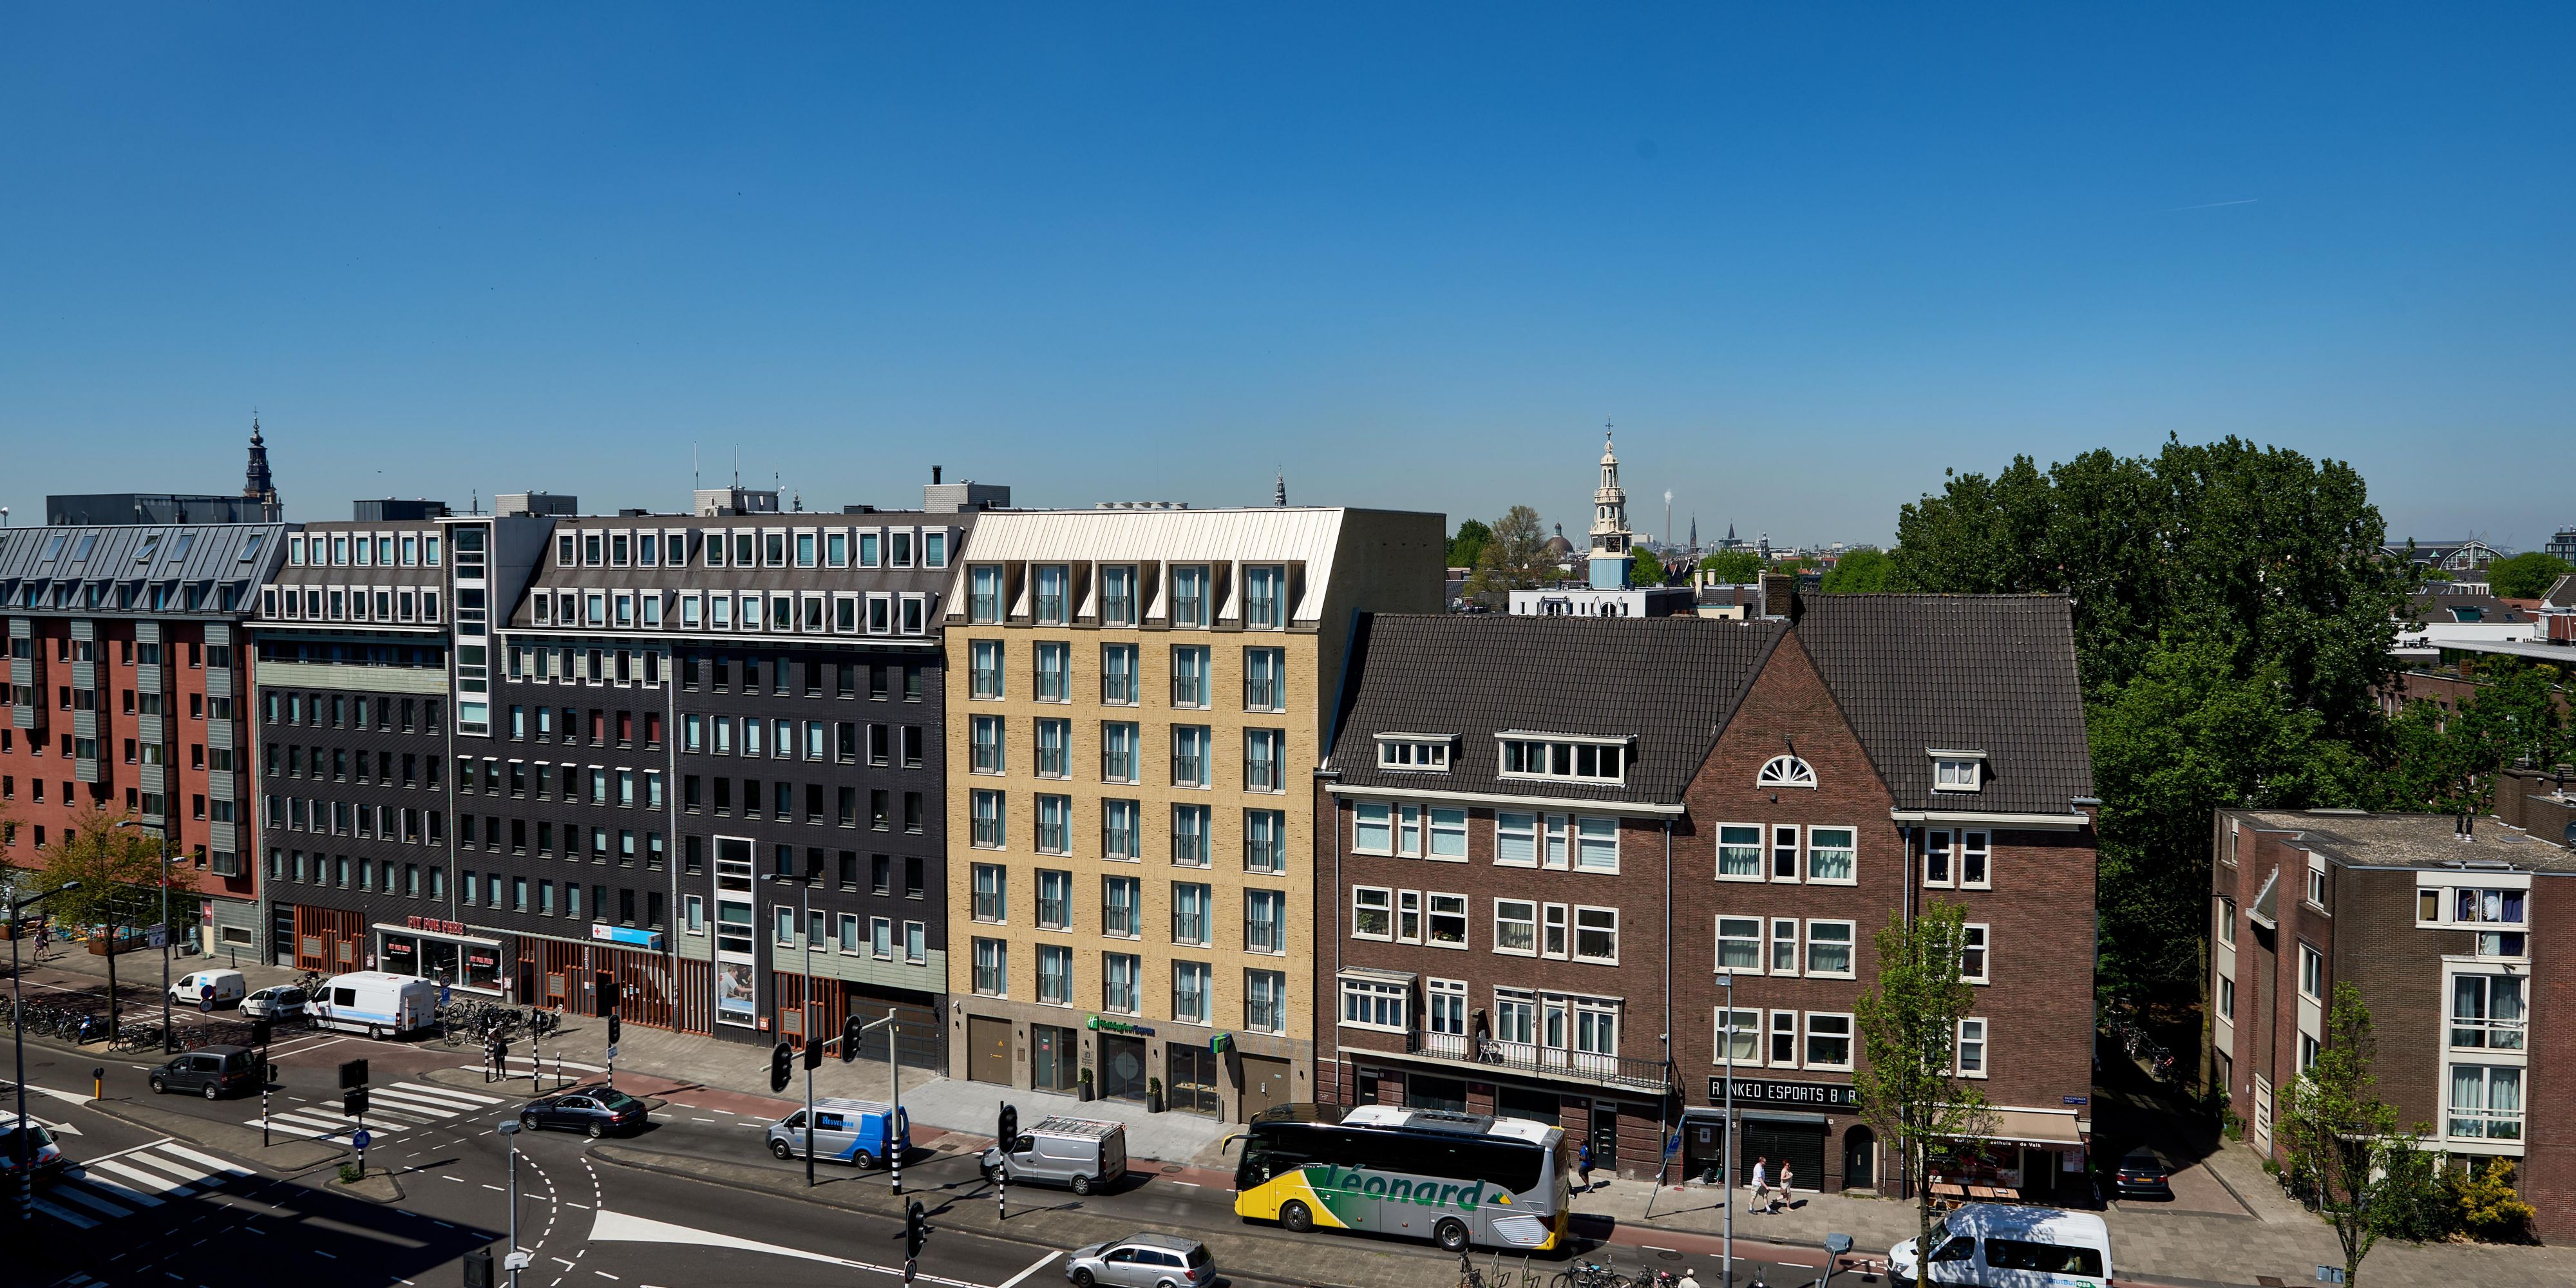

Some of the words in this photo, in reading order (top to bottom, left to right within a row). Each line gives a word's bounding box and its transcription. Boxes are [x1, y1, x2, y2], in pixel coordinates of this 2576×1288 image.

[408, 915, 421, 929] FIT
[423, 917, 440, 931] FOR
[442, 920, 464, 934] FREE
[1099, 1019, 1122, 1030] Holiday
[1768, 1085, 1823, 1101] ESPORTS
[1830, 1089, 1855, 1103] BAR
[1671, 1137, 1680, 1146] P
[1322, 1163, 1486, 1211] Léonard
